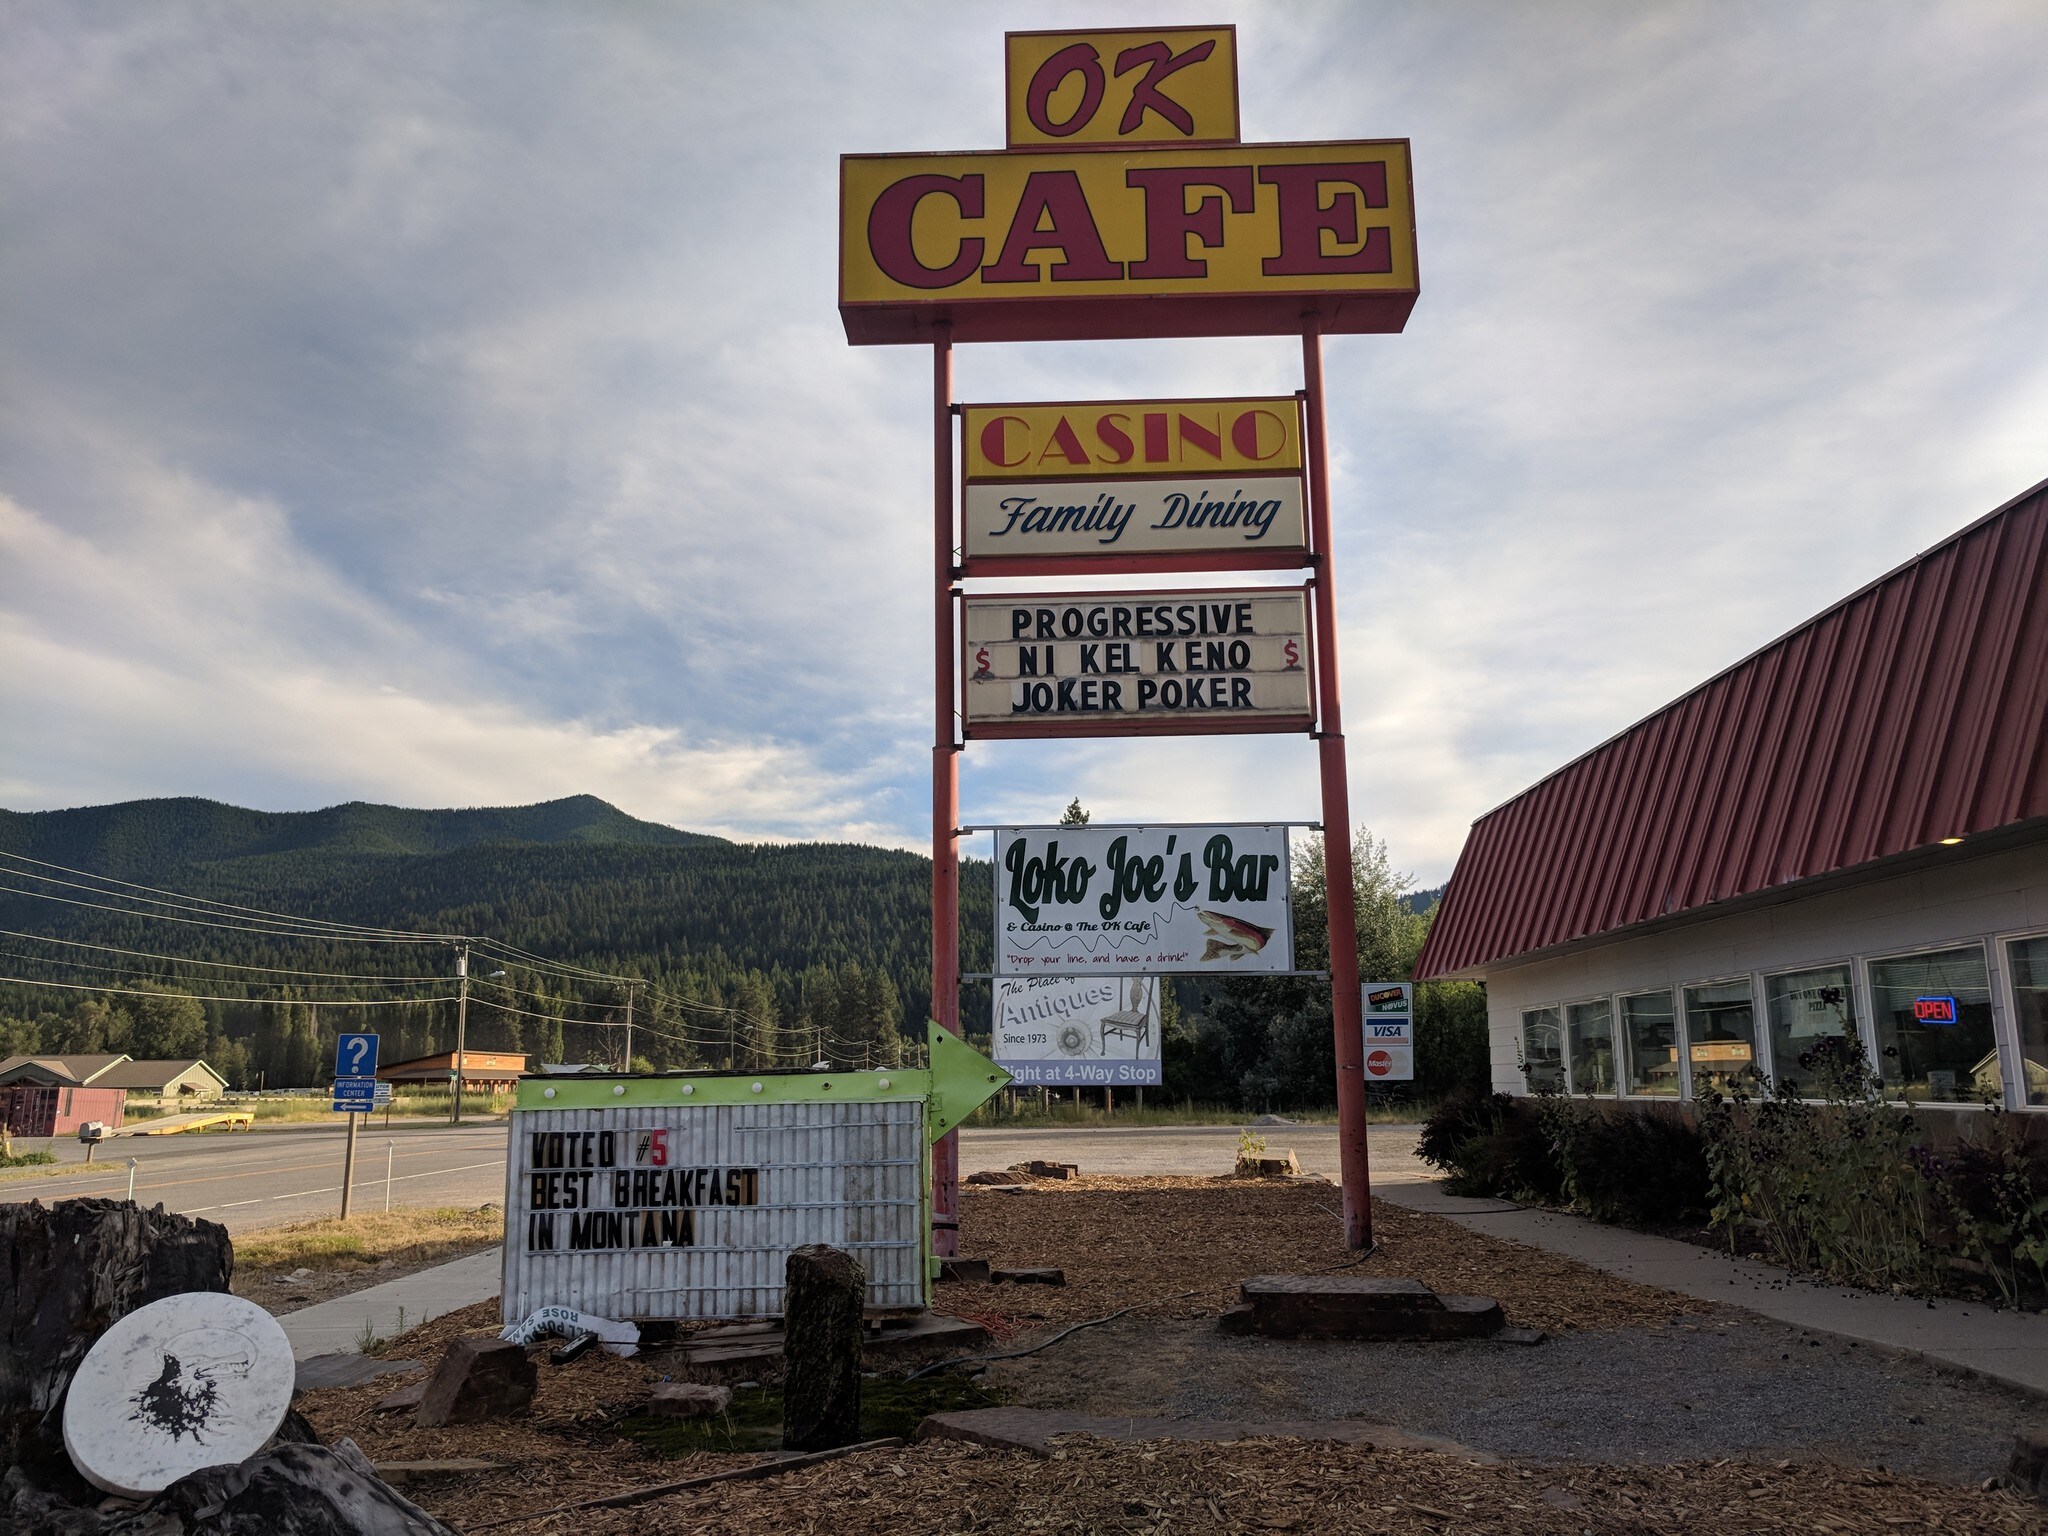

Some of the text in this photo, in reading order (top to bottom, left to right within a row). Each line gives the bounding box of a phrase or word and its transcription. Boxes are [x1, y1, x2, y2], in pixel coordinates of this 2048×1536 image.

[1027, 40, 1216, 137] OK
[868, 161, 1393, 289] CAFE
[980, 409, 1288, 467] CASINO
[989, 489, 1282, 543] Family Dining
[1012, 603, 1253, 639] PROGRESSIVE
[1156, 639, 1251, 673] KENO
[1012, 676, 1253, 713] JOKER POKER
[1005, 833, 1279, 924] Loko Joe's Bar
[1006, 920, 1151, 933] & Casino @ The OK Cafe
[1040, 954, 1061, 966] your
[1067, 953, 1087, 964] line,
[1092, 952, 1110, 963] and
[1115, 952, 1140, 963] have
[1001, 982, 1024, 997] The
[1027, 977, 1060, 991] Place
[999, 985, 1114, 1029] Antiques
[1382, 1000, 1408, 1011] NOVUS
[1914, 1002, 1952, 1019] OPEN
[1003, 1033, 1047, 1044] Since 1973
[1374, 1026, 1402, 1036] VISA
[1046, 1065, 1060, 1081] at
[1065, 1065, 1114, 1084] 4-Way
[1119, 1065, 1156, 1084] Stop
[532, 1129, 668, 1169] VOTED #5
[531, 1168, 758, 1210] BEST BREAKFAST
[528, 1210, 695, 1251] IN MONTANA
